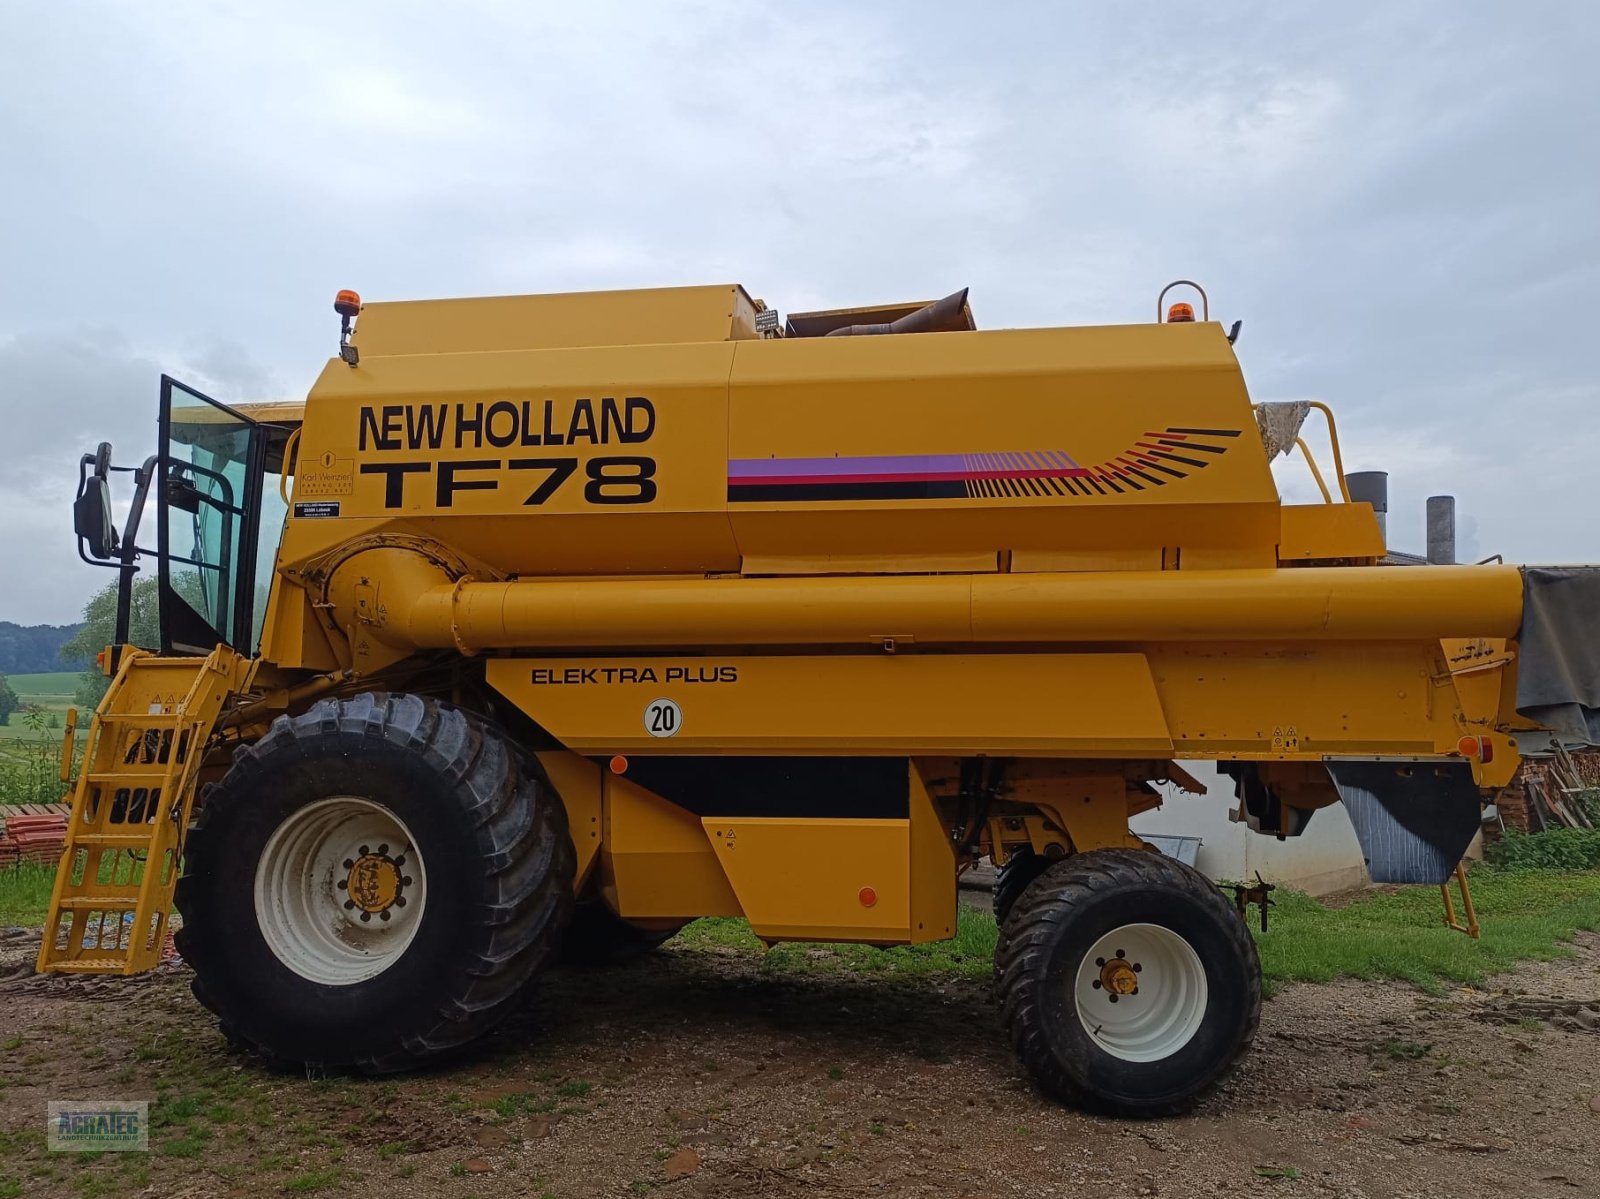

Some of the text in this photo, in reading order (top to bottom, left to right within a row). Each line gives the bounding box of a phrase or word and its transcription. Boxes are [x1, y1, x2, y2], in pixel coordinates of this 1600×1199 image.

[359, 397, 656, 451] NEW HOLLAND
[302, 472, 317, 482] Karl
[360, 456, 657, 509] TF78
[531, 666, 737, 684] ELEKTRA PLUS
[651, 705, 675, 731] 20
